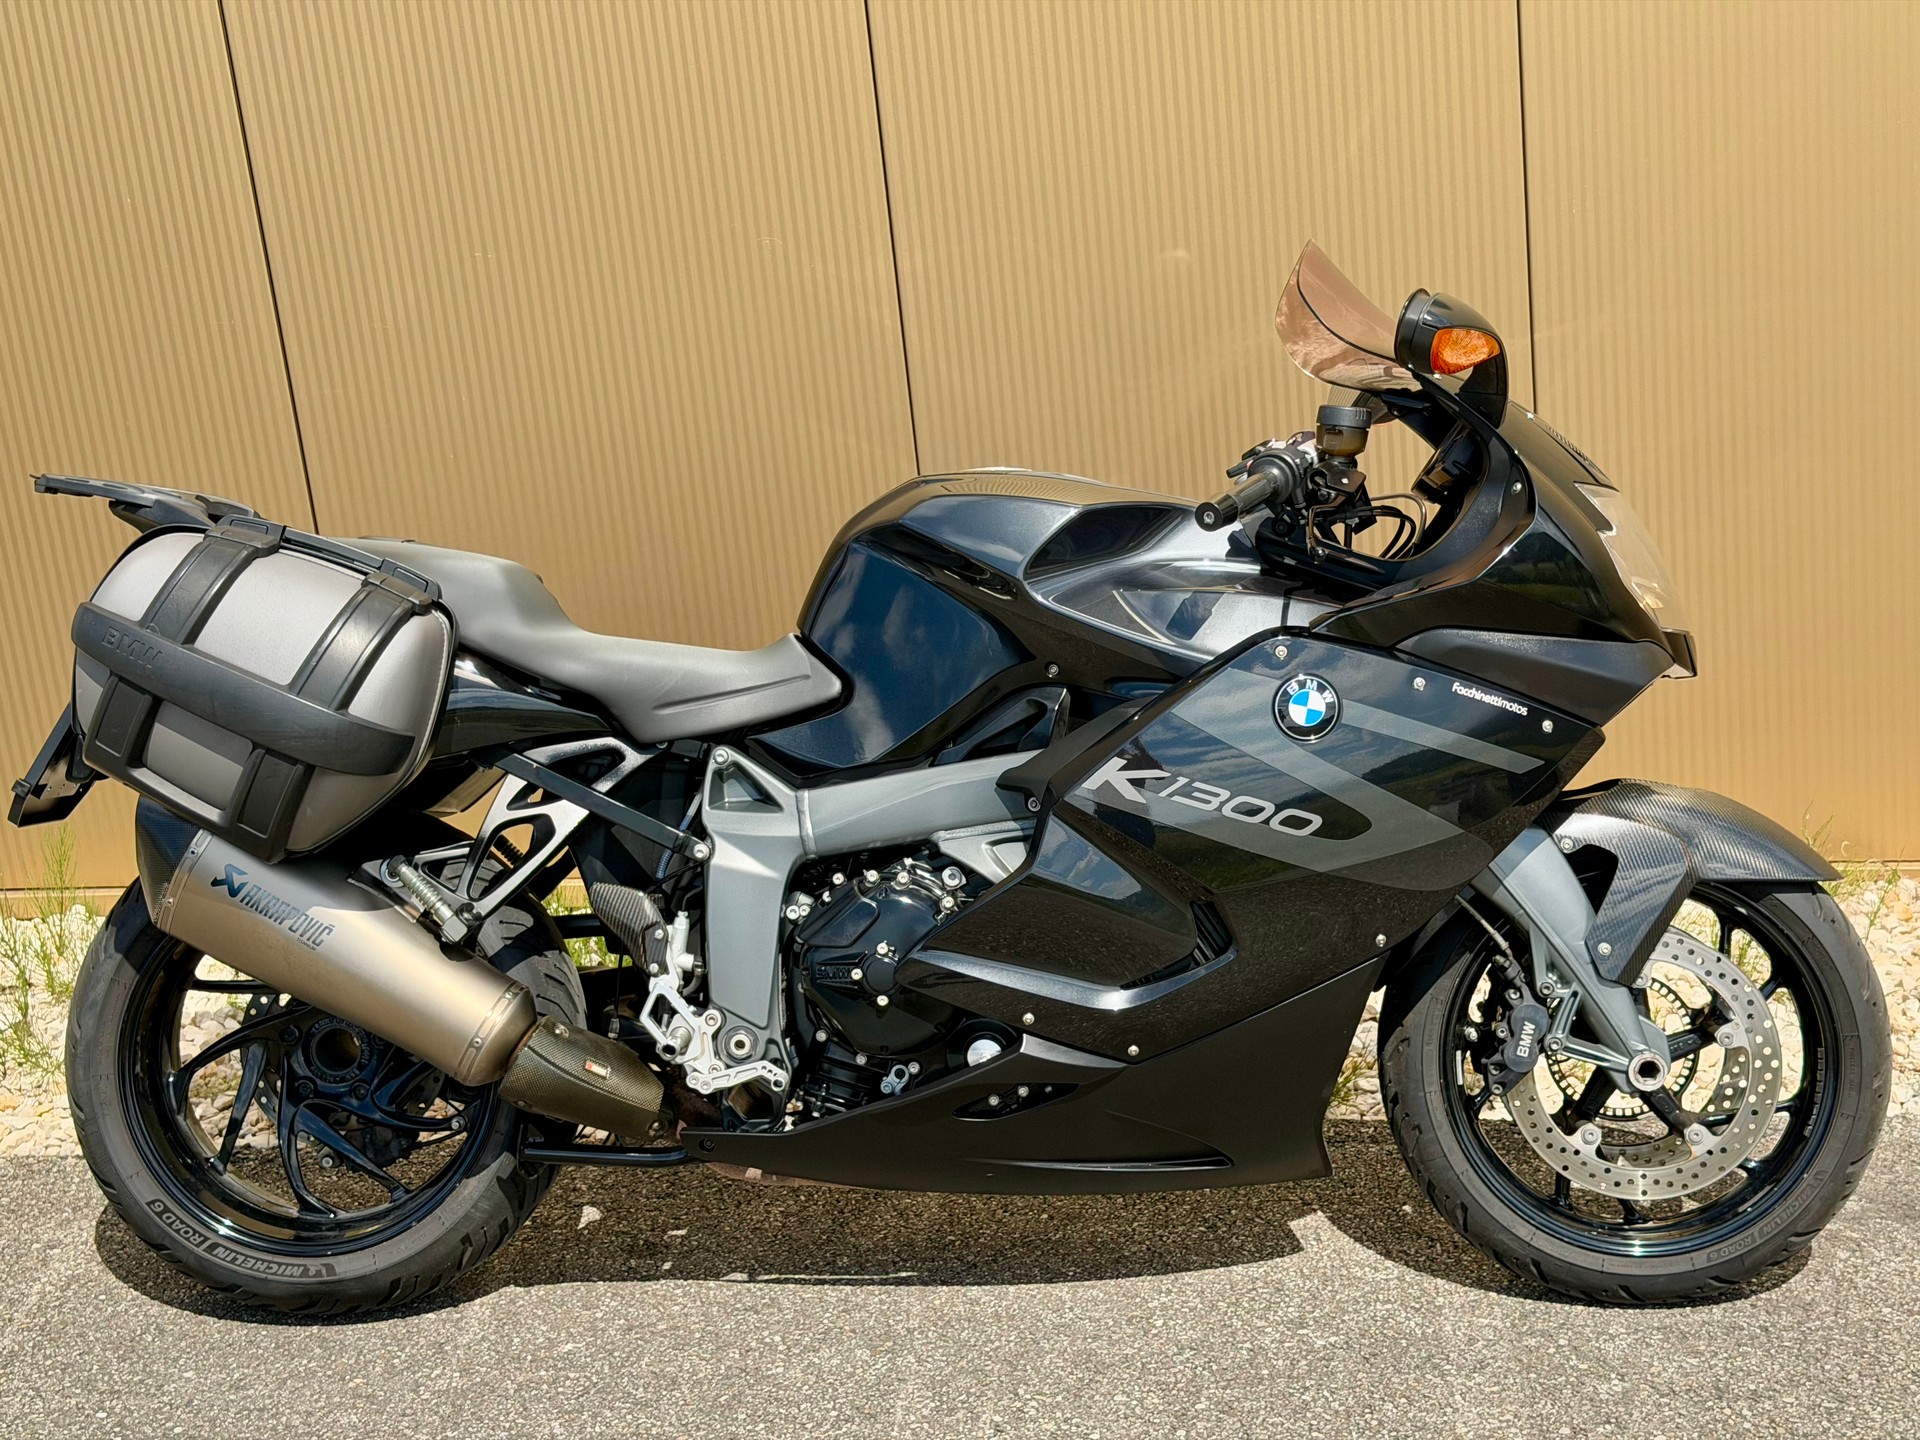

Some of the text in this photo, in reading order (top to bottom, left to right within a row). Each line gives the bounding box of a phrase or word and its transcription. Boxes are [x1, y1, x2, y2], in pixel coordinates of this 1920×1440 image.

[101, 626, 163, 668] BMW
[1286, 679, 1335, 703] BMW
[816, 966, 850, 980] BMW
[1516, 1021, 1536, 1058] BMW
[150, 1201, 304, 1277] MICHELIN ROAD 6
[1709, 1187, 1811, 1260] MICHELIN ROAD 6
